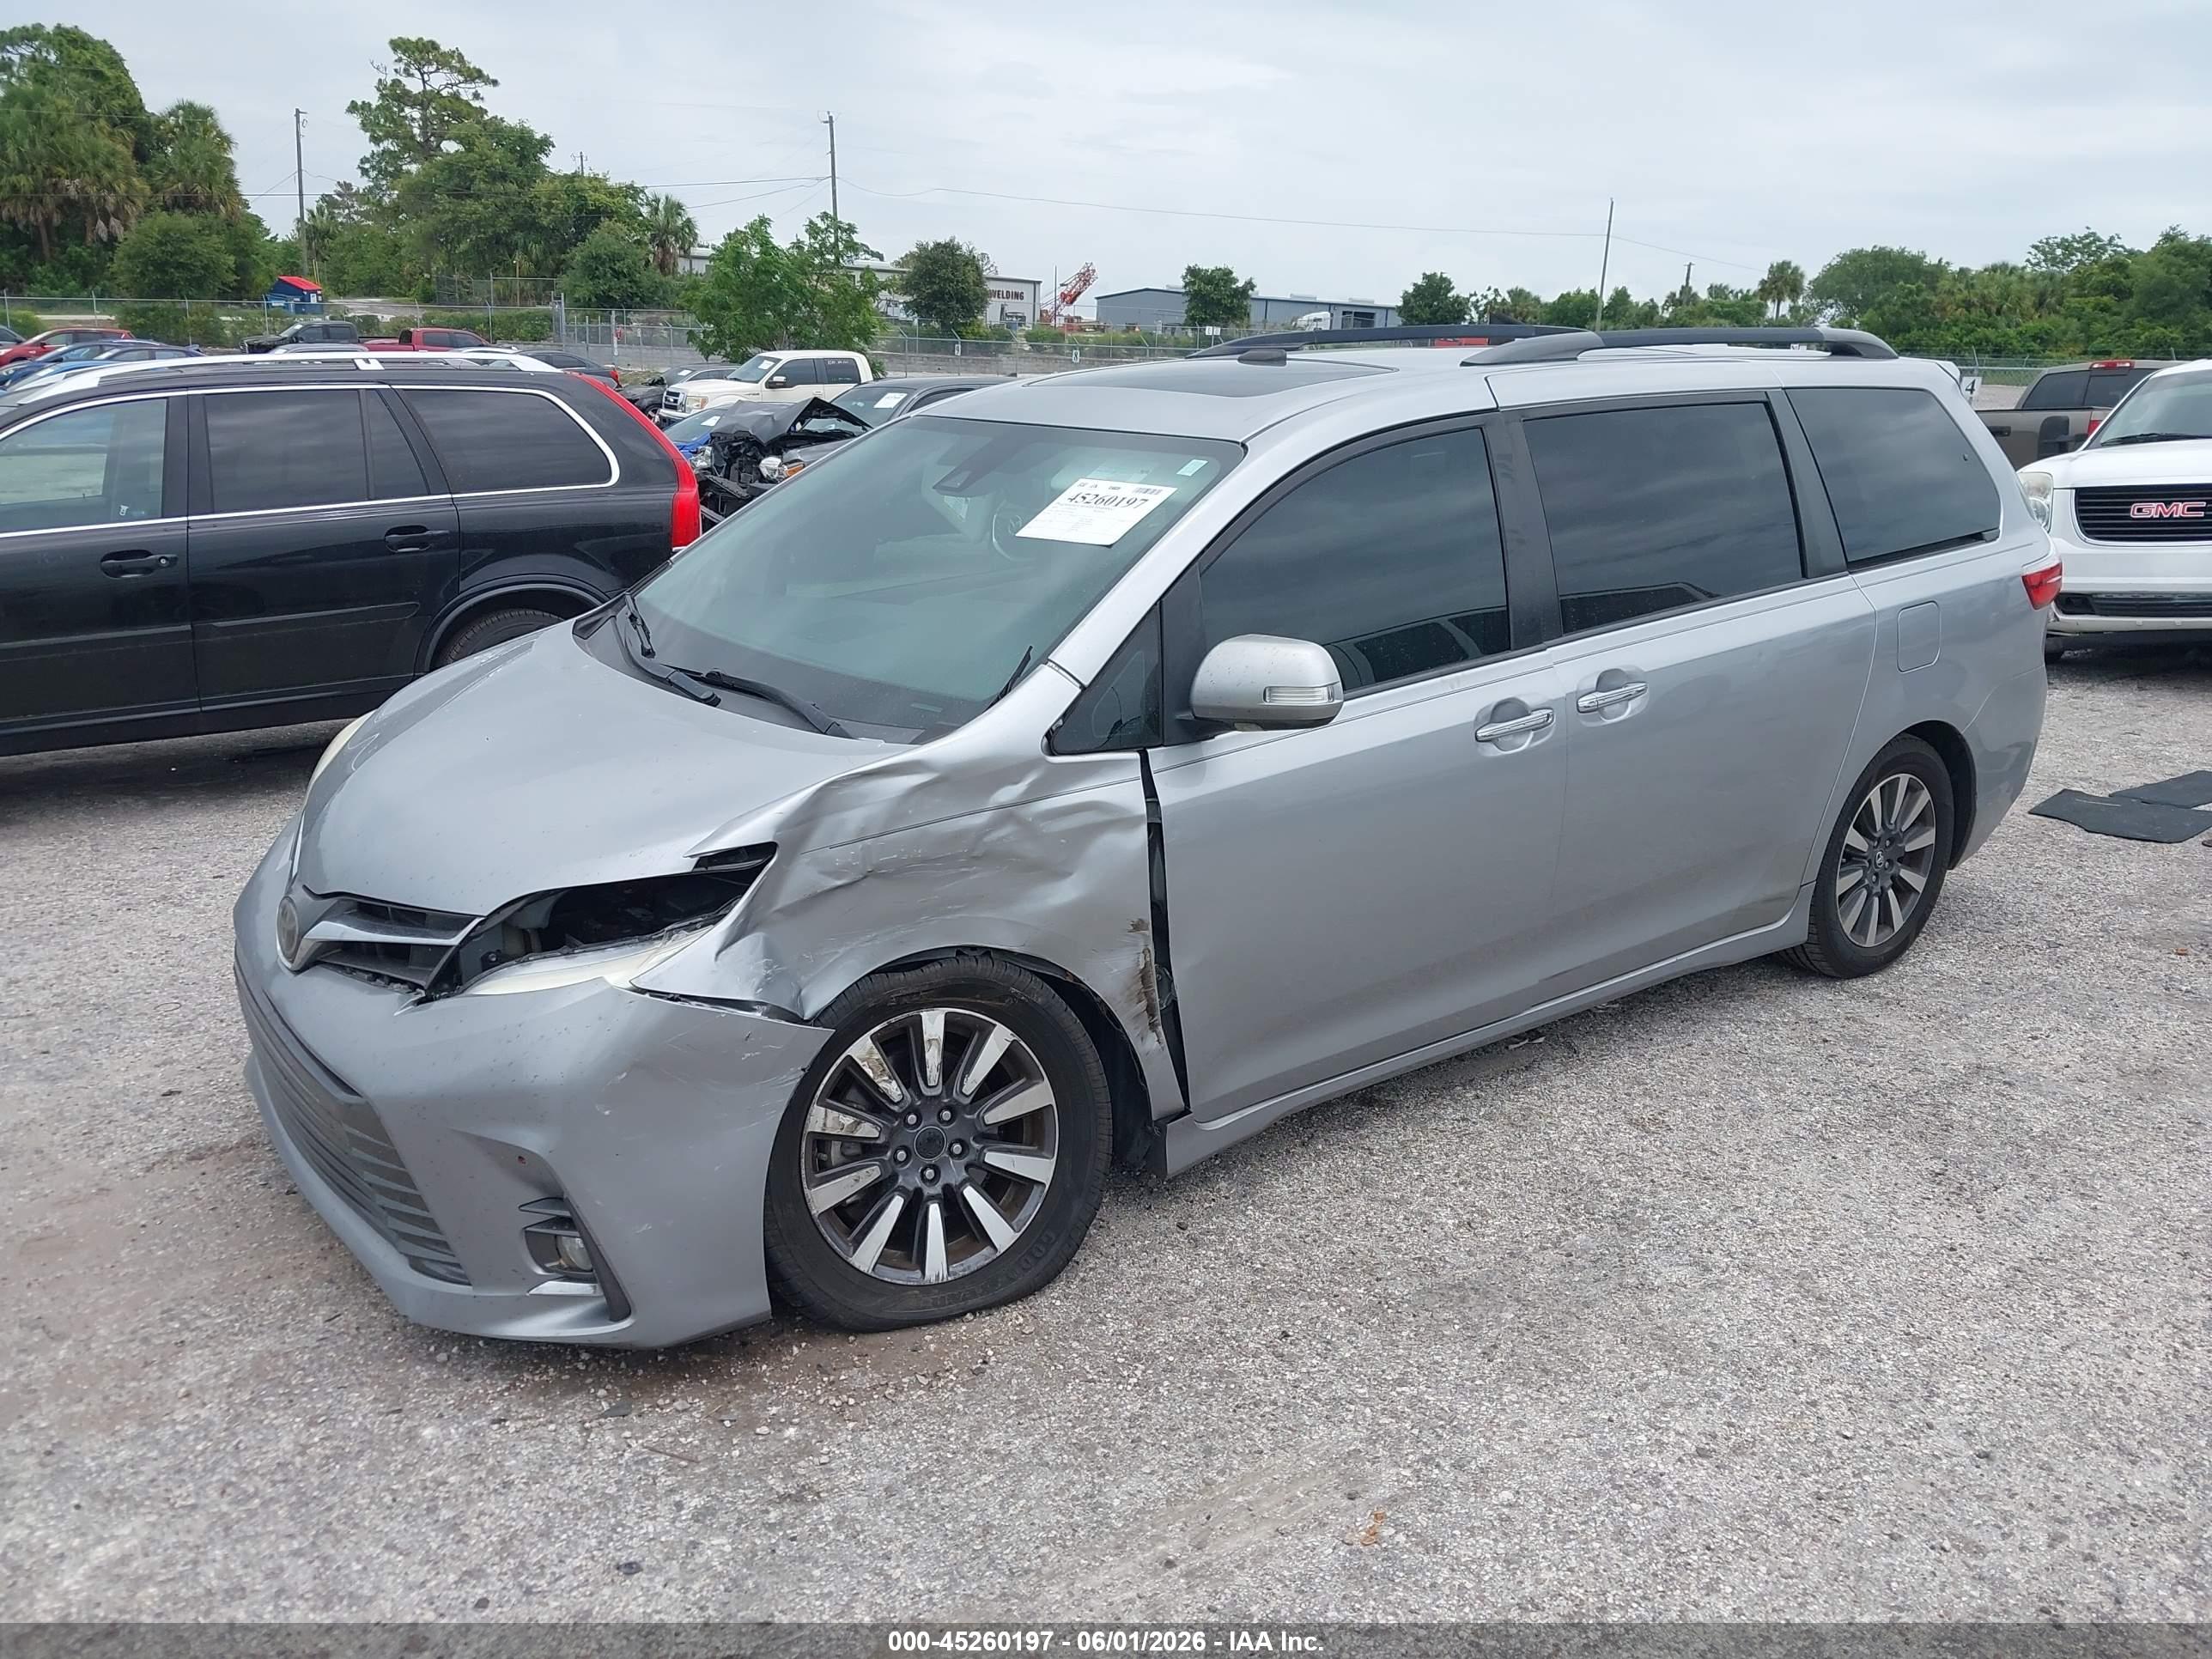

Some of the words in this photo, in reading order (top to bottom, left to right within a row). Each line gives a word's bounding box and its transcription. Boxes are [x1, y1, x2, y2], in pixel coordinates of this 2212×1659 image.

[989, 289, 1024, 301] WELDING
[1965, 379, 1976, 395] 4
[1066, 492, 1149, 509] 45260197
[2130, 501, 2206, 519] GMC
